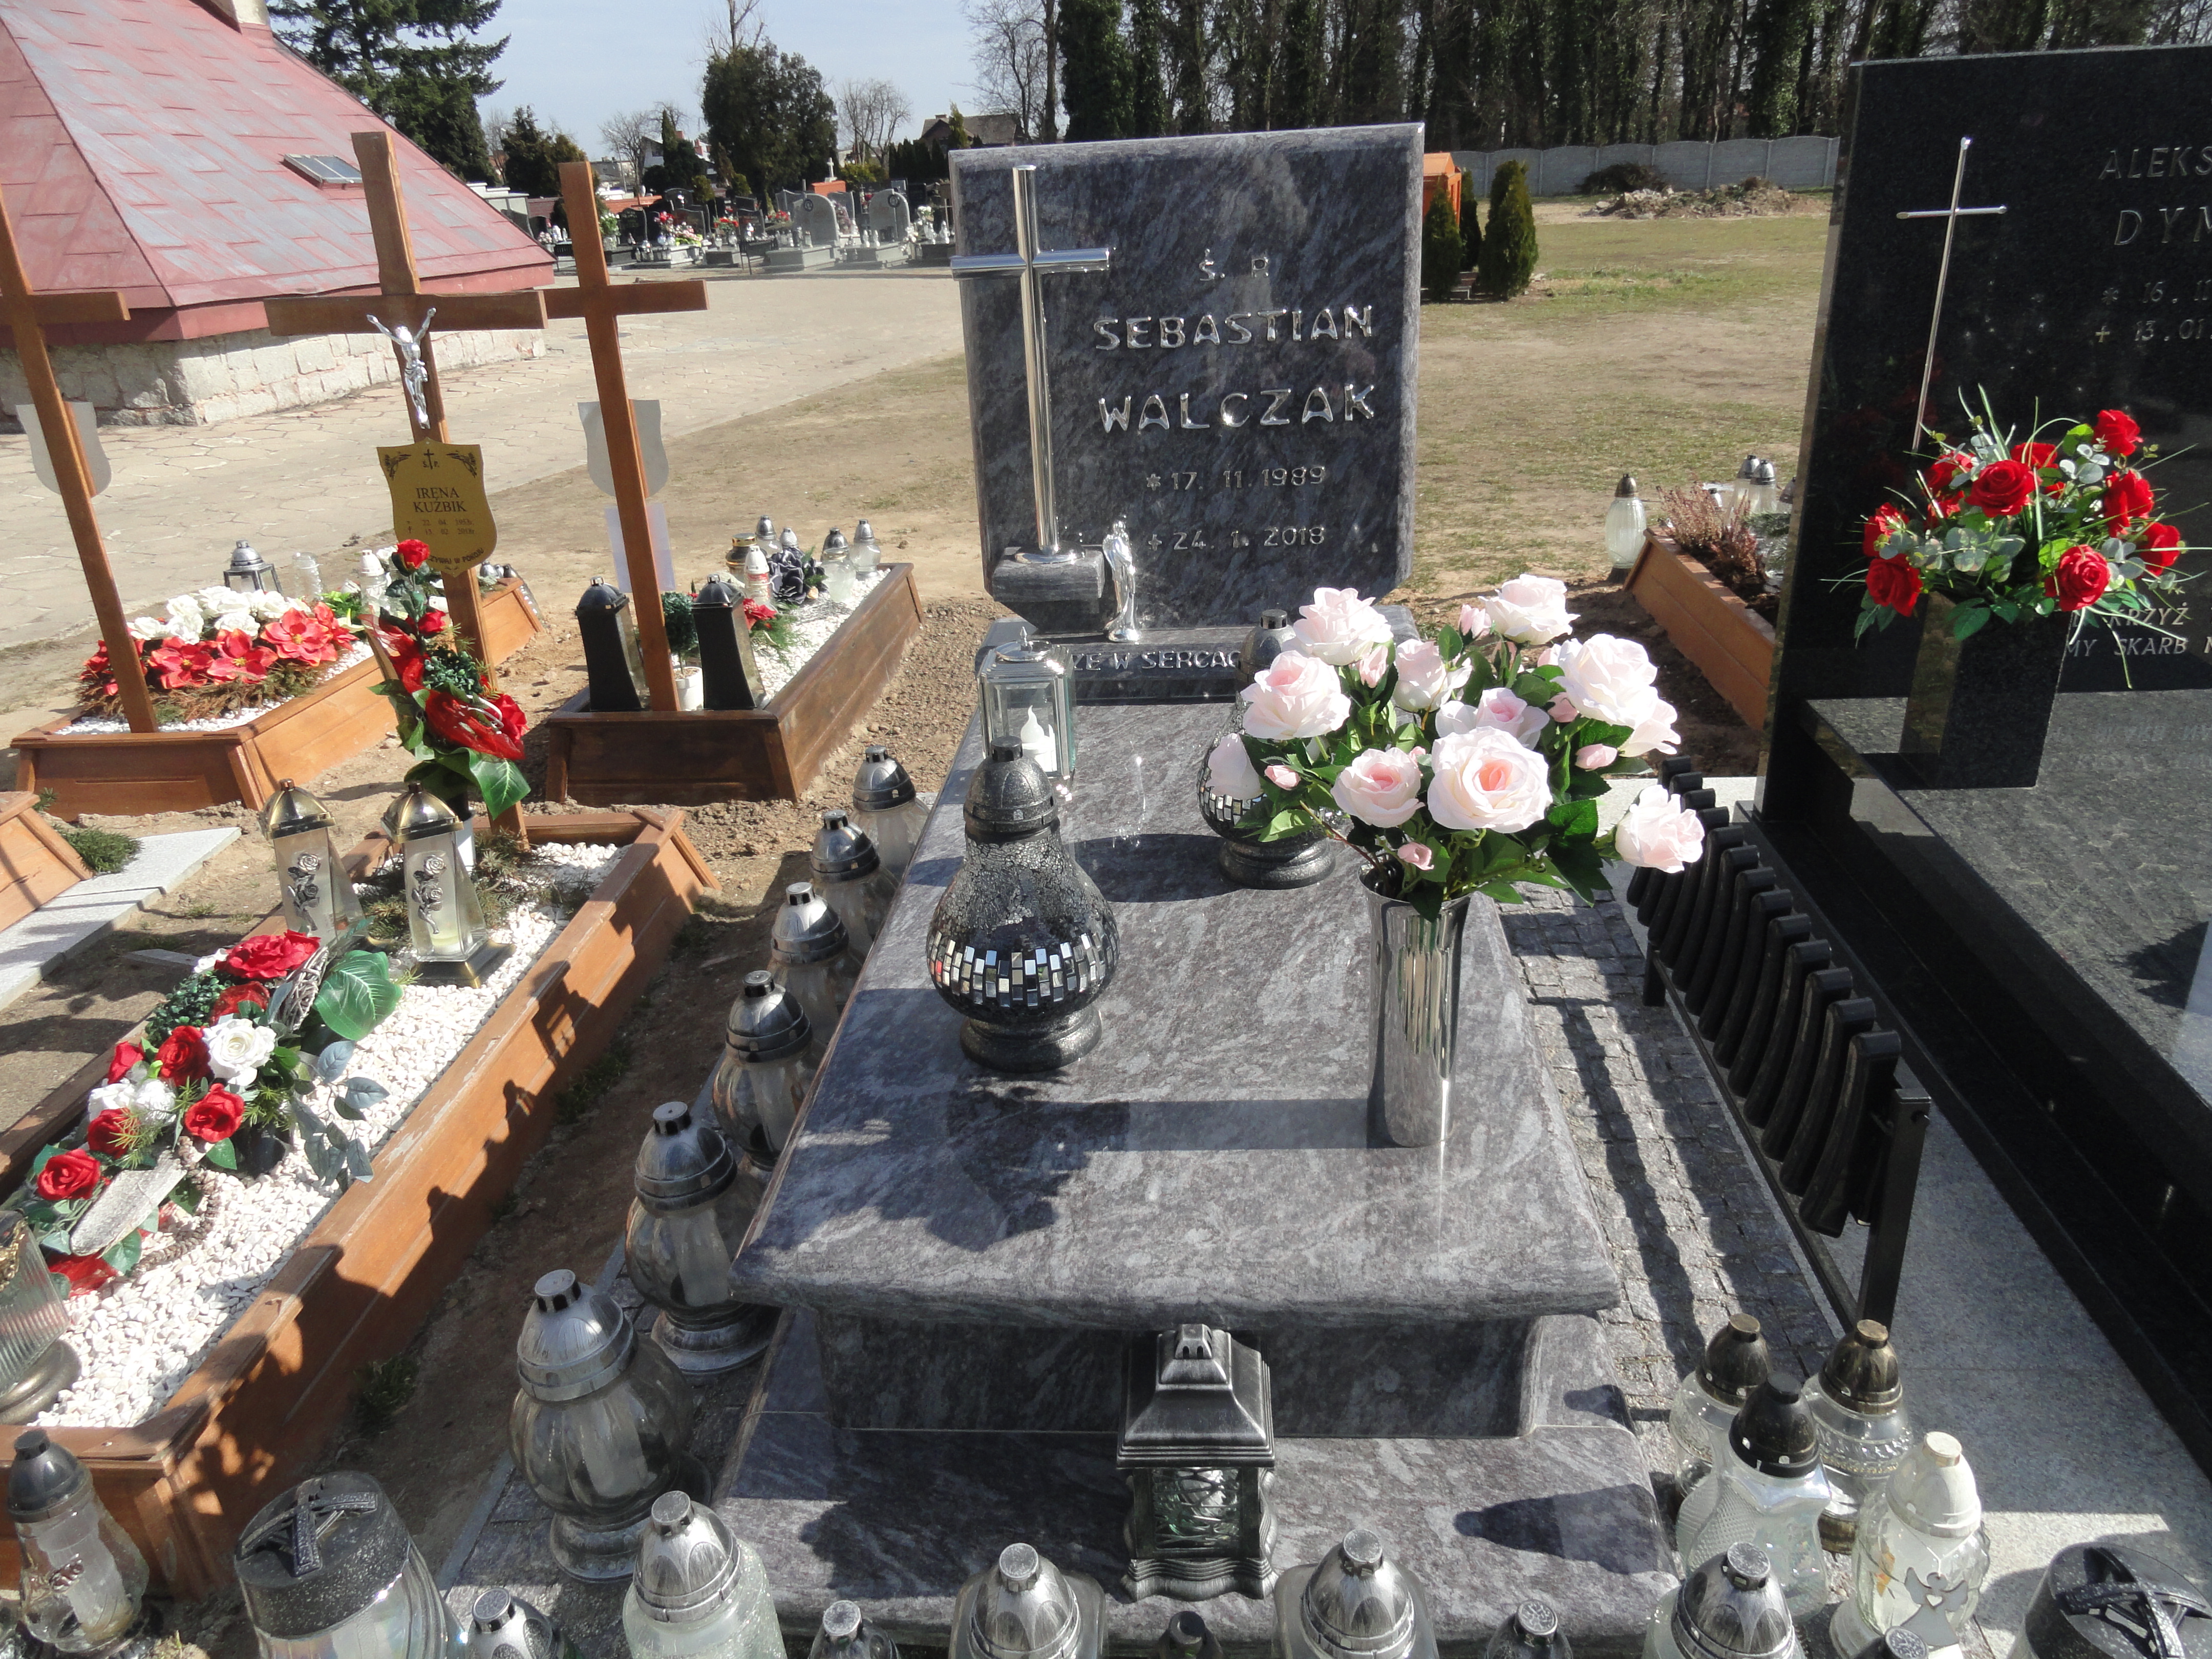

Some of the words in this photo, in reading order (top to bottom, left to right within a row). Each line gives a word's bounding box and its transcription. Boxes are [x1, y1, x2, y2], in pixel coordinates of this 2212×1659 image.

[1094, 305, 1372, 350] SEBASTIAN
[1098, 384, 1374, 434] WALCZAK
[1261, 465, 1326, 487] 1989
[415, 486, 460, 499] IRENA
[1264, 525, 1326, 548] 2018
[2113, 636, 2188, 656] SKARB
[1114, 652, 1130, 670] W
